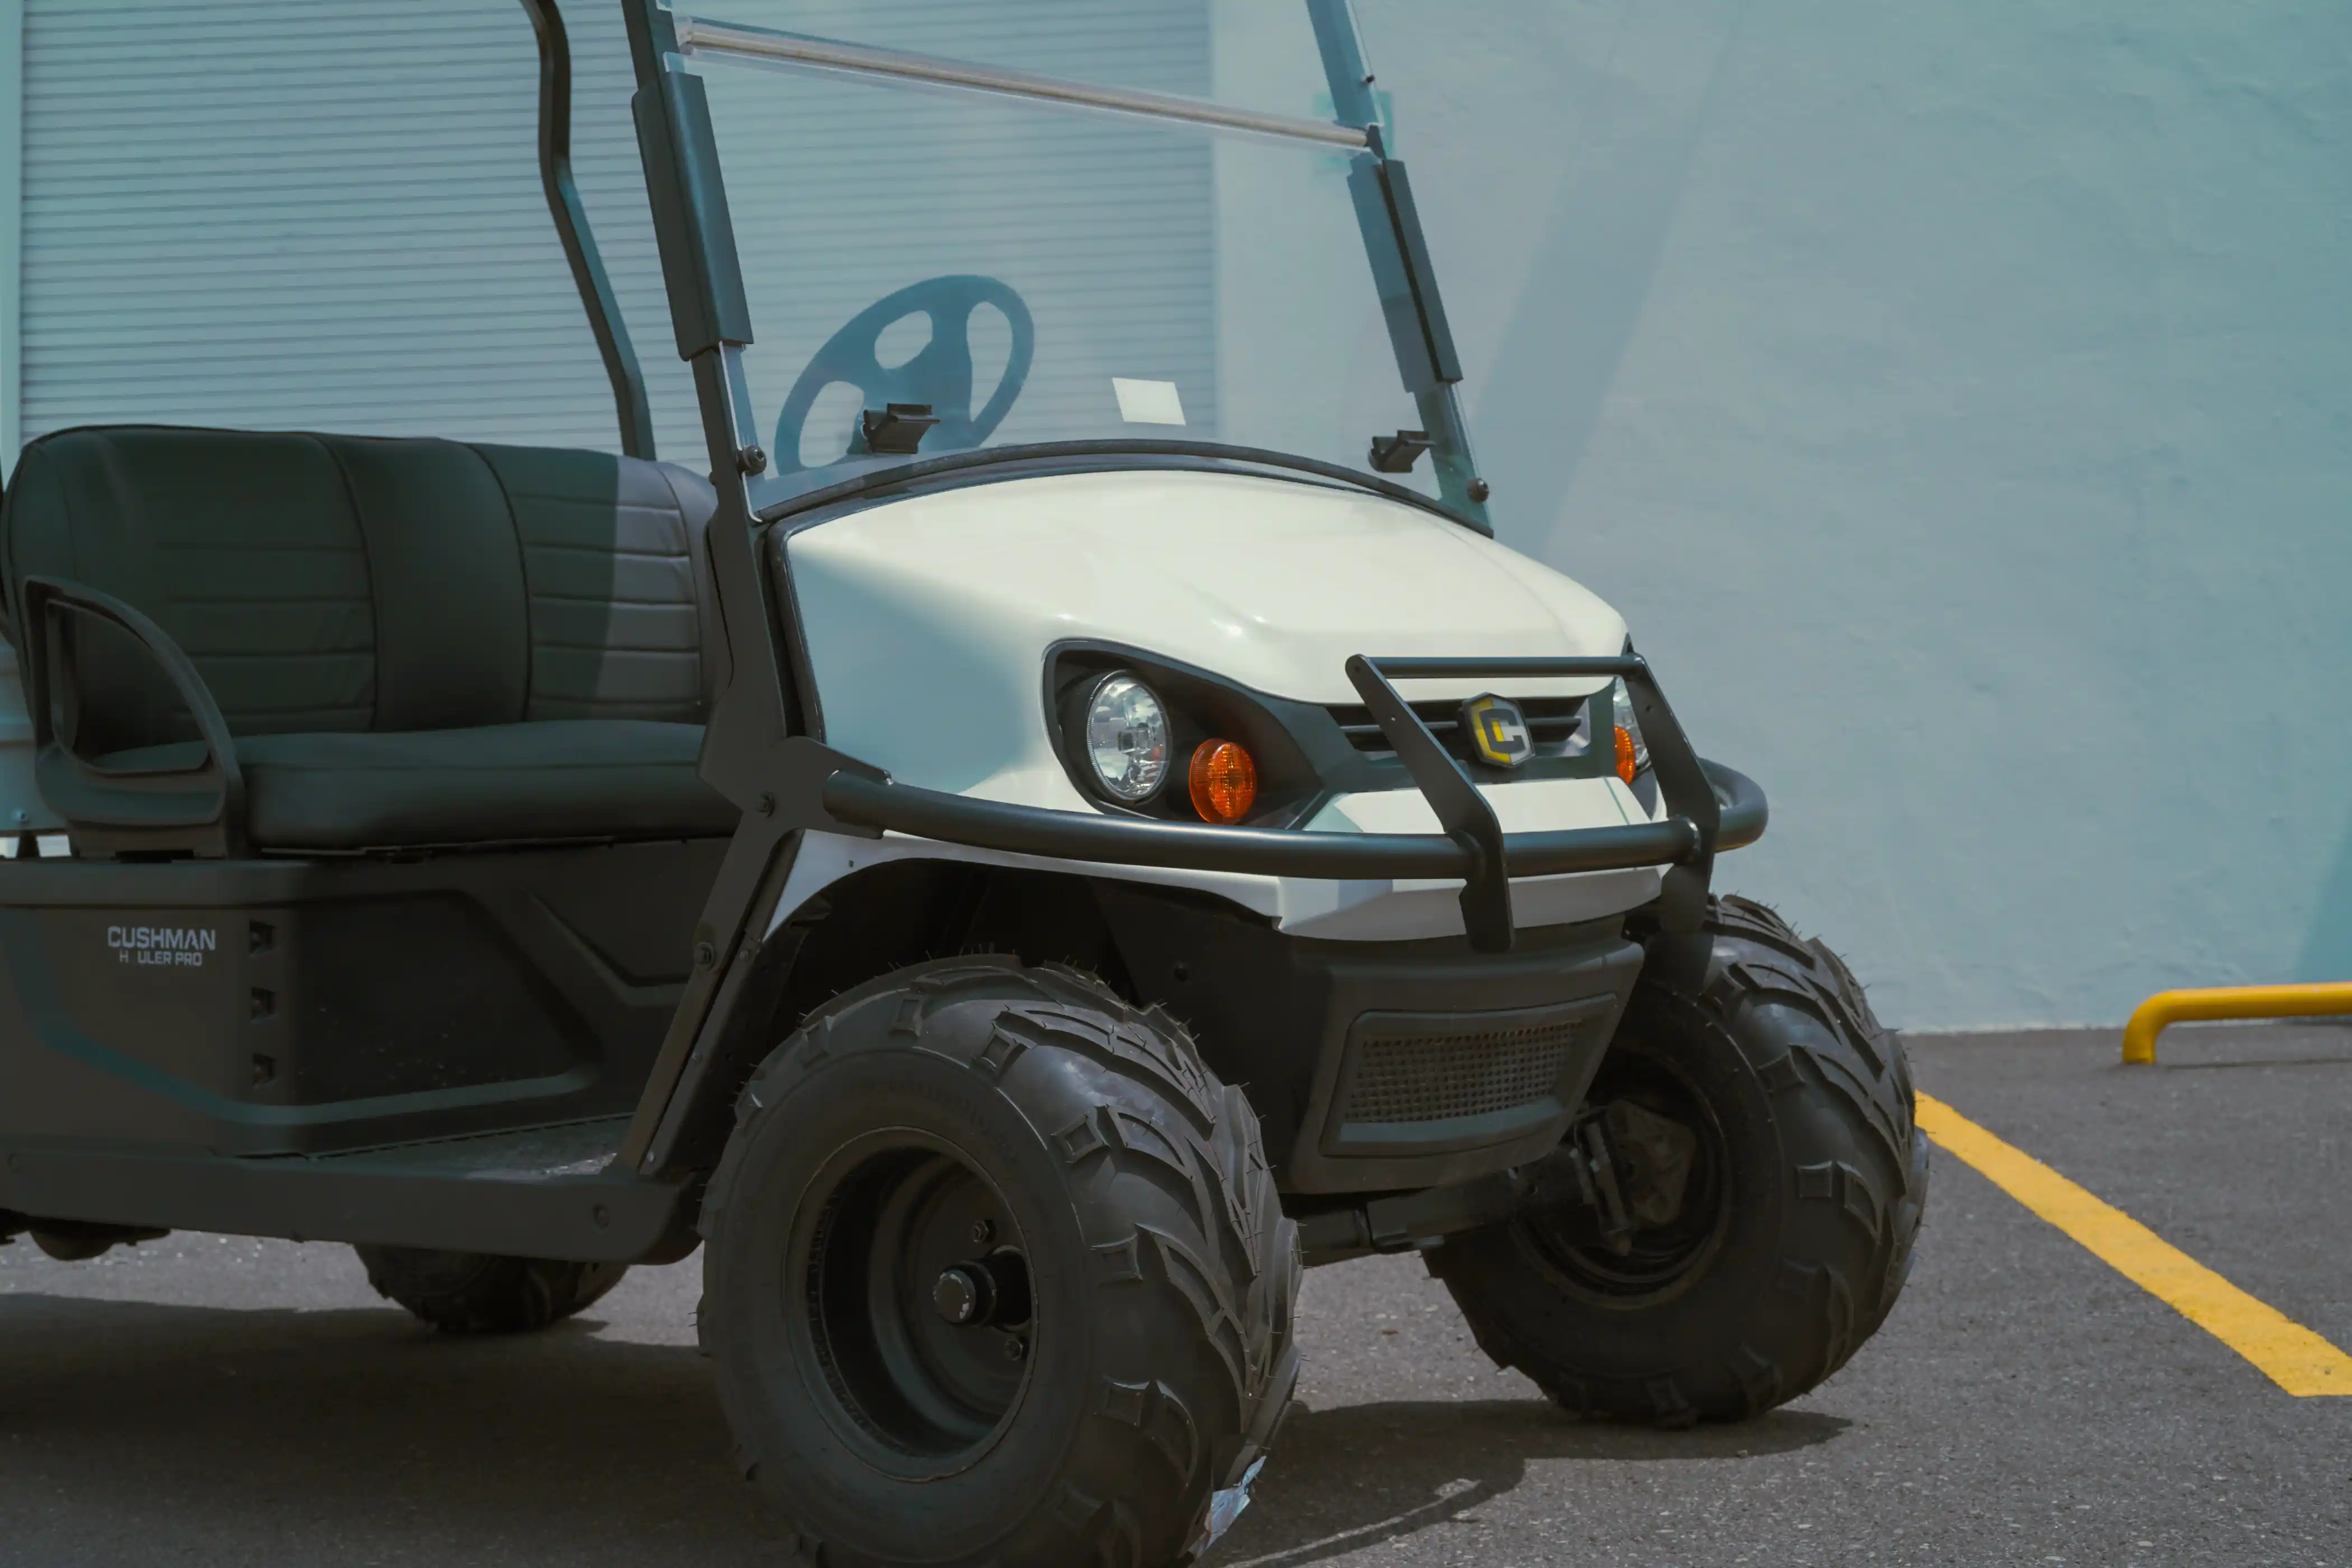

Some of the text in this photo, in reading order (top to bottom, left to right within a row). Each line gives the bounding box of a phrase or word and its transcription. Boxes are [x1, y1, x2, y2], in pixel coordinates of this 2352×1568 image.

[1477, 706, 1528, 755] C
[108, 926, 216, 951] CUSHMAN
[119, 950, 203, 967] HULER PRO
